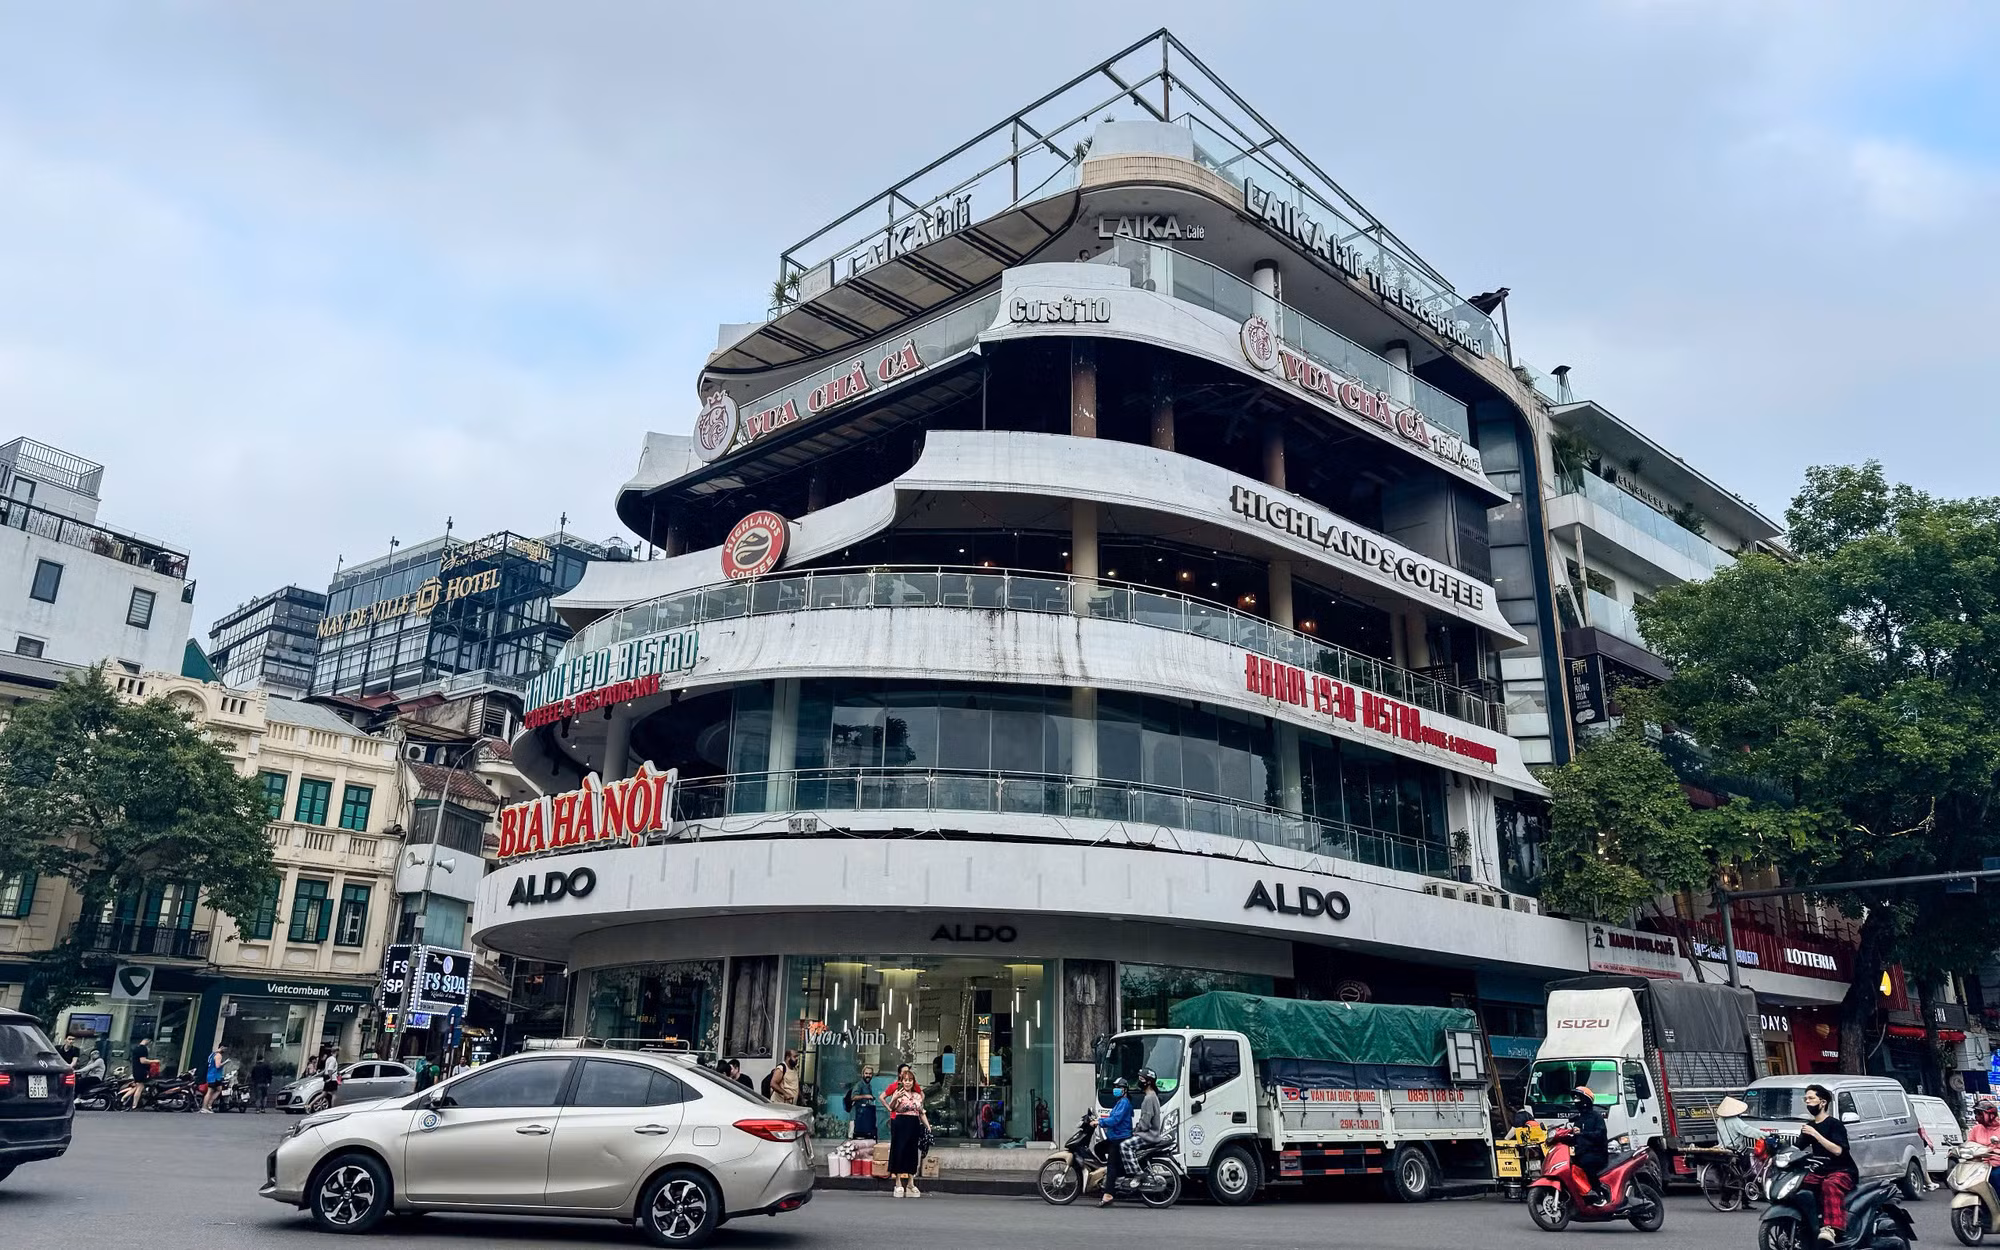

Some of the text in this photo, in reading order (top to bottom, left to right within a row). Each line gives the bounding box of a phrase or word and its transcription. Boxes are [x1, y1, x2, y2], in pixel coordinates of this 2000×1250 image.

[847, 193, 972, 280] LAIKA Café
[1098, 214, 1183, 240] LAIKA
[1244, 176, 1330, 260] LAIKA
[1367, 268, 1401, 302] The
[1401, 289, 1486, 360] Exceptional
[1009, 293, 1111, 322] Cơ sở 10
[747, 338, 923, 441] VUA CHẢ CÁ
[1280, 350, 1338, 403] VUA
[1338, 380, 1395, 431] CHẢ
[1395, 407, 1432, 448] CÁ
[724, 514, 782, 580] HIGHLANDS COFFEE
[1231, 484, 1484, 611] HIGHLANDS COFFEE
[317, 567, 501, 639] MAY DE VILLE HOTEL
[523, 629, 700, 716] HANOI 1930 BISTRO
[1244, 652, 1309, 708] HANOI
[1311, 674, 1357, 722] 1930
[524, 674, 662, 730] COFFEE & RESTAURANT
[497, 765, 671, 859] BIA HÀ NỘI
[507, 866, 597, 906] ALDO
[1243, 879, 1351, 921] ALDO
[930, 923, 1018, 943] ALDO
[392, 960, 409, 974] FS
[1786, 947, 1838, 971] LOTTERIA
[267, 982, 331, 997] Vietcombank
[423, 971, 442, 991] FS
[442, 974, 466, 995] SPA
[332, 1004, 354, 1014] ATM
[1556, 1019, 1610, 1029] ISUZU
[1760, 1014, 1789, 1032] DAYS
